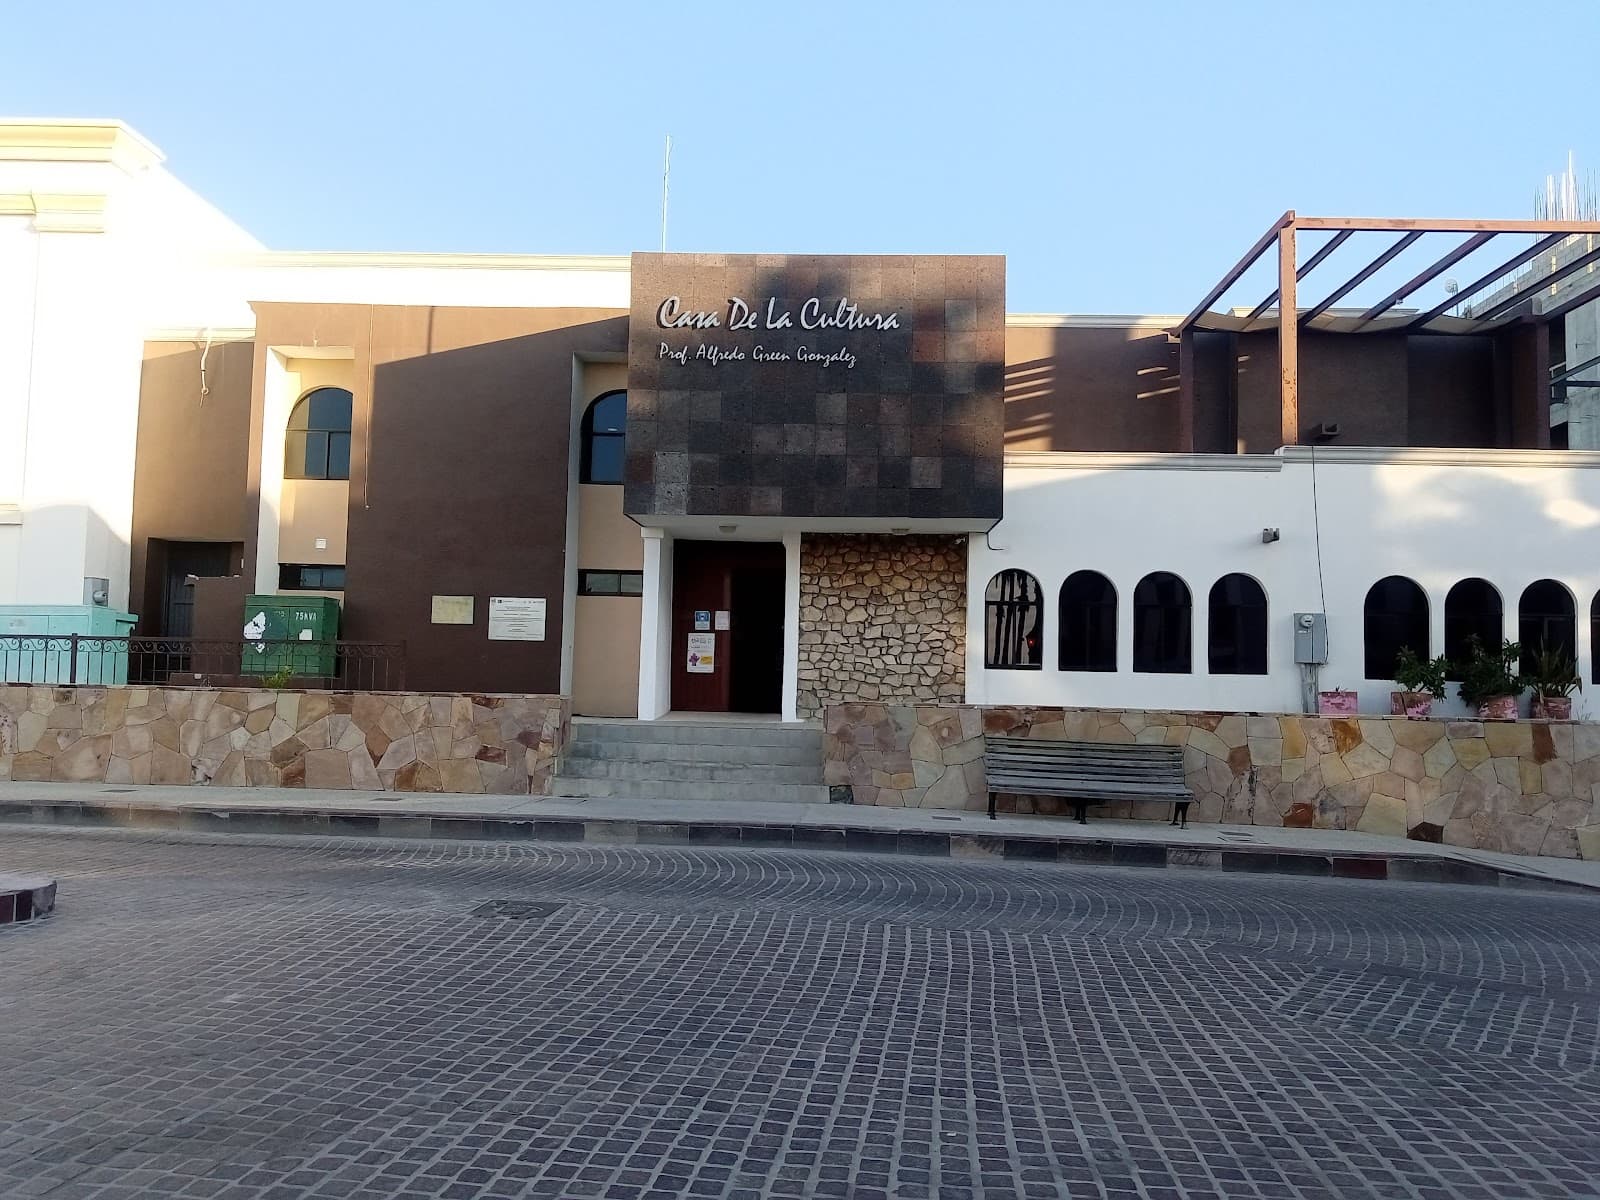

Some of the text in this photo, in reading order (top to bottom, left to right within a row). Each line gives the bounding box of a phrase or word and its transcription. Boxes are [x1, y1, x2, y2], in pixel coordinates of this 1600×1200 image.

[658, 295, 900, 331] Casa De La Cultura
[659, 342, 857, 369] Prof. Alfredo Green Gonzalez
